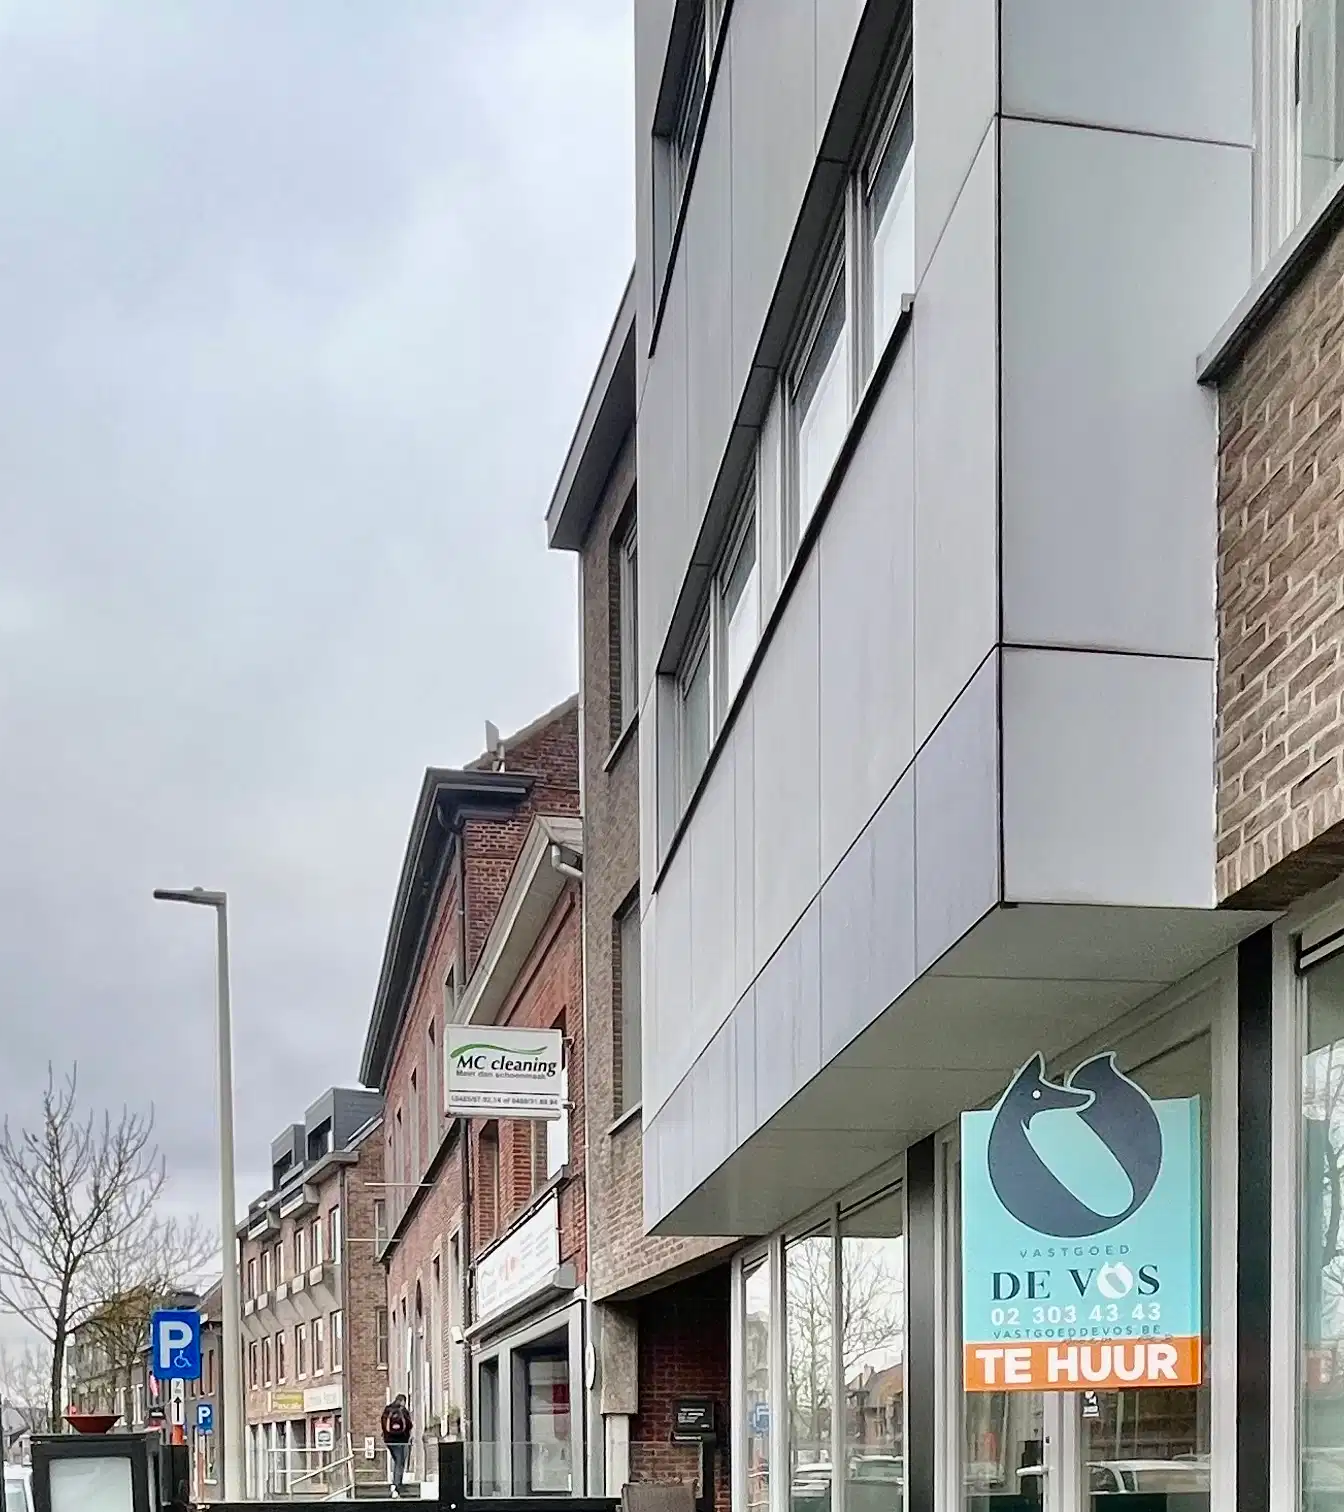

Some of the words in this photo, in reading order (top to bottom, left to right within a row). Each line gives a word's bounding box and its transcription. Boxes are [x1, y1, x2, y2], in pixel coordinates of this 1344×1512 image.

[456, 1055, 486, 1070] MC
[491, 1055, 557, 1077] cleaning
[1020, 1244, 1130, 1258] VASTGOED
[991, 1270, 1051, 1301] DE
[1067, 1262, 1161, 1299] VOS
[991, 1307, 1021, 1326] 02
[1032, 1304, 1077, 1325] 303
[1088, 1303, 1118, 1322] 43
[1131, 1302, 1161, 1321] 43
[993, 1325, 1161, 1340] VASTGOEDDEVOS.BE
[159, 1321, 193, 1369] P
[975, 1348, 1032, 1385] TE
[1047, 1343, 1179, 1384] HUUR
[198, 1406, 211, 1424] P
